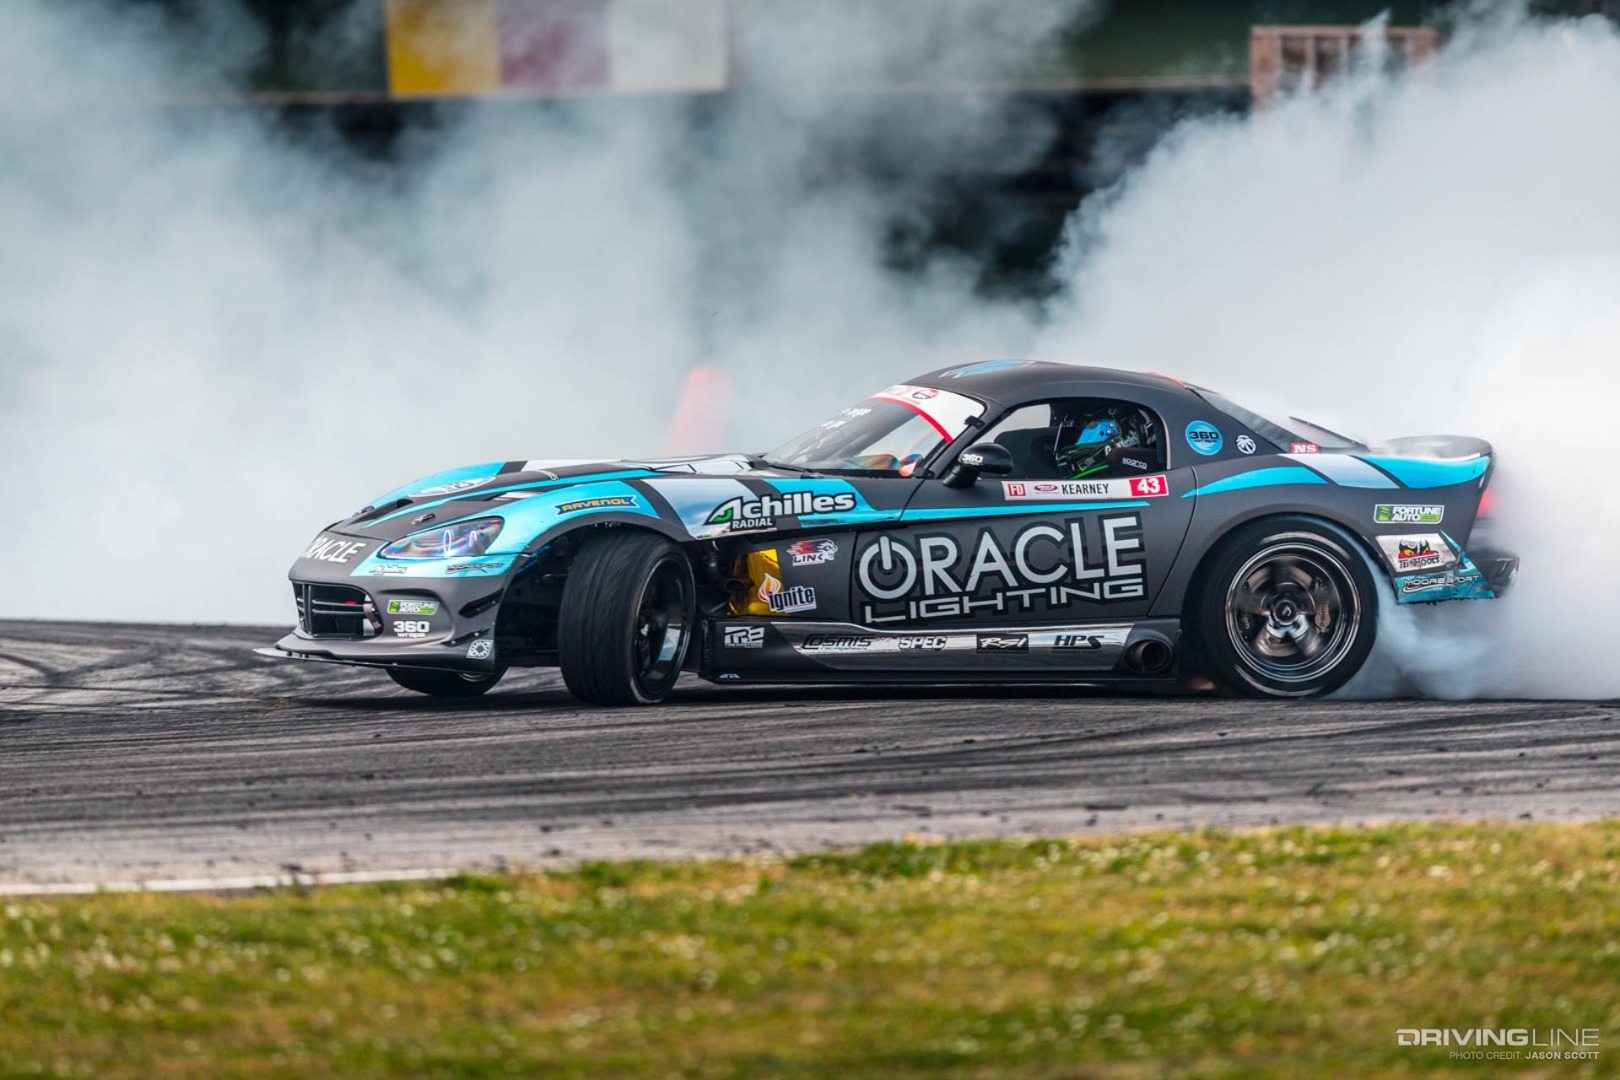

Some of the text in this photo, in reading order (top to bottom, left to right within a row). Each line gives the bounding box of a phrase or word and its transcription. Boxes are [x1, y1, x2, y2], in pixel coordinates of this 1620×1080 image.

[1189, 431, 1219, 440] 360
[1293, 444, 1317, 454] NS
[1061, 483, 1109, 495] KEARNEY
[1137, 478, 1161, 494] 43
[561, 499, 630, 512] RAVENOL
[706, 491, 856, 523] Achilles
[1392, 506, 1442, 515] FORTUNE
[732, 517, 773, 530] RADIAL
[858, 516, 1143, 600] ORACLE
[768, 588, 815, 611] ignite
[865, 578, 1144, 623] LIGHTING
[393, 621, 430, 632] 360
[899, 635, 947, 650] SPEC
